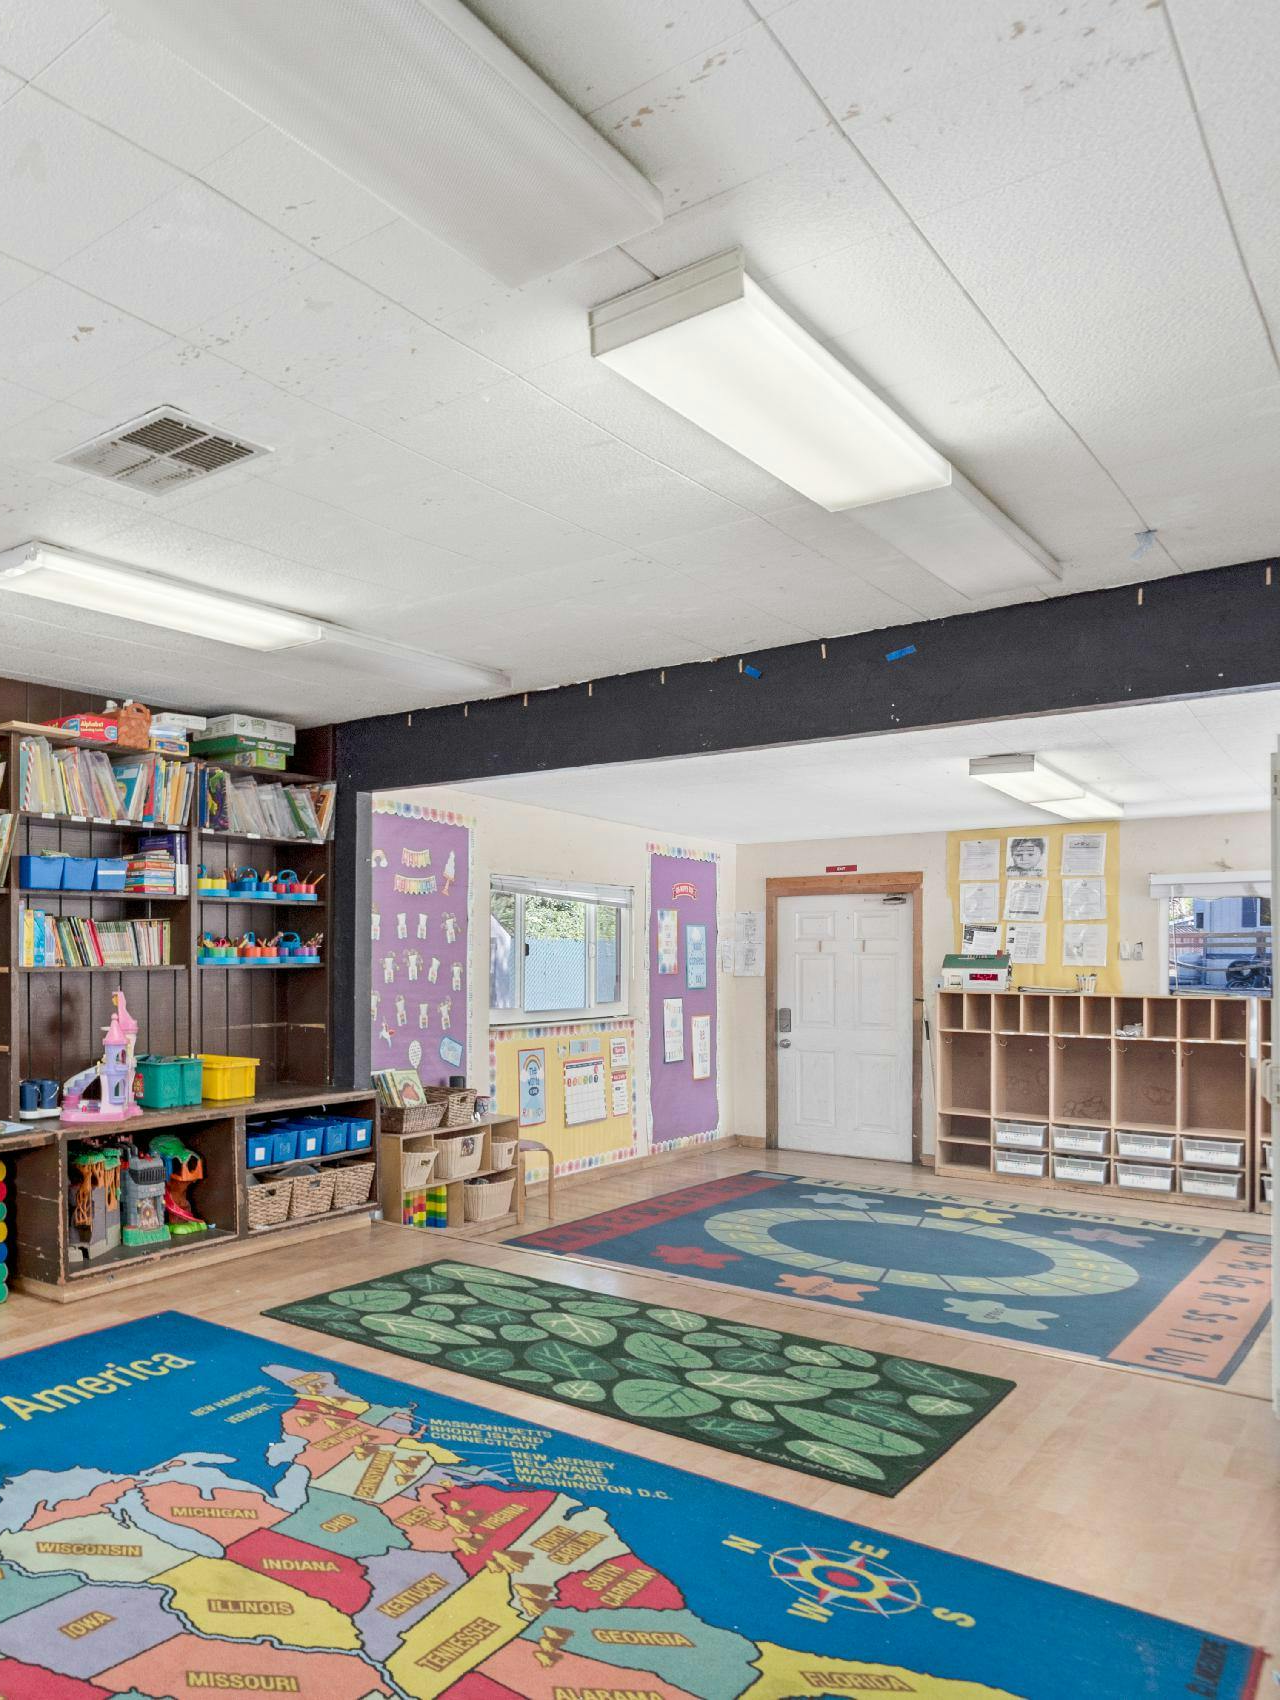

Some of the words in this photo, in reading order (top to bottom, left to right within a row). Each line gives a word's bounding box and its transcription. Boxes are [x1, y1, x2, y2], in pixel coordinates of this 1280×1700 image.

[80, 719, 104, 728] Alphabet
[1181, 1308, 1238, 1324] Ss
[1166, 1327, 1224, 1344] Tt
[1144, 1346, 1209, 1366] Uu
[0, 1347, 197, 1421] America
[429, 1418, 552, 1439] MASSACHUSETTS
[430, 1425, 484, 1439] RHODE
[486, 1432, 544, 1444] ISLAND
[430, 1432, 538, 1450] CONNECTICUT
[511, 1451, 548, 1462] NEW
[553, 1455, 616, 1471] JERSEY
[512, 1459, 604, 1476] DELAWARE
[514, 1466, 609, 1484] MARYLAND
[516, 1474, 633, 1496] WASHINGTON
[638, 1487, 673, 1500] D.C.
[171, 1506, 258, 1520] MICHIGAN
[320, 1513, 358, 1534] OHIO
[395, 1504, 435, 1527] WEST
[478, 1503, 529, 1531] VIRGINIA
[530, 1525, 579, 1551] NORTH
[547, 1530, 608, 1565] CAROLINA
[722, 1534, 763, 1555] N
[36, 1541, 143, 1558] WISCONSIN
[848, 1540, 890, 1560] E
[261, 1557, 341, 1573] INDIANA
[581, 1563, 625, 1591] SOUTH
[599, 1568, 658, 1607] CAROLINA
[376, 1572, 450, 1619] KENTUCKY
[208, 1599, 295, 1616] ILLINOIS
[786, 1597, 835, 1624] W
[931, 1605, 977, 1630] S
[58, 1611, 117, 1640] IOWA
[415, 1617, 501, 1672] TENNESSEE
[592, 1628, 696, 1648] GEORGIA
[186, 1671, 300, 1692] MISSOURI
[801, 1670, 917, 1692] FLORIDA
